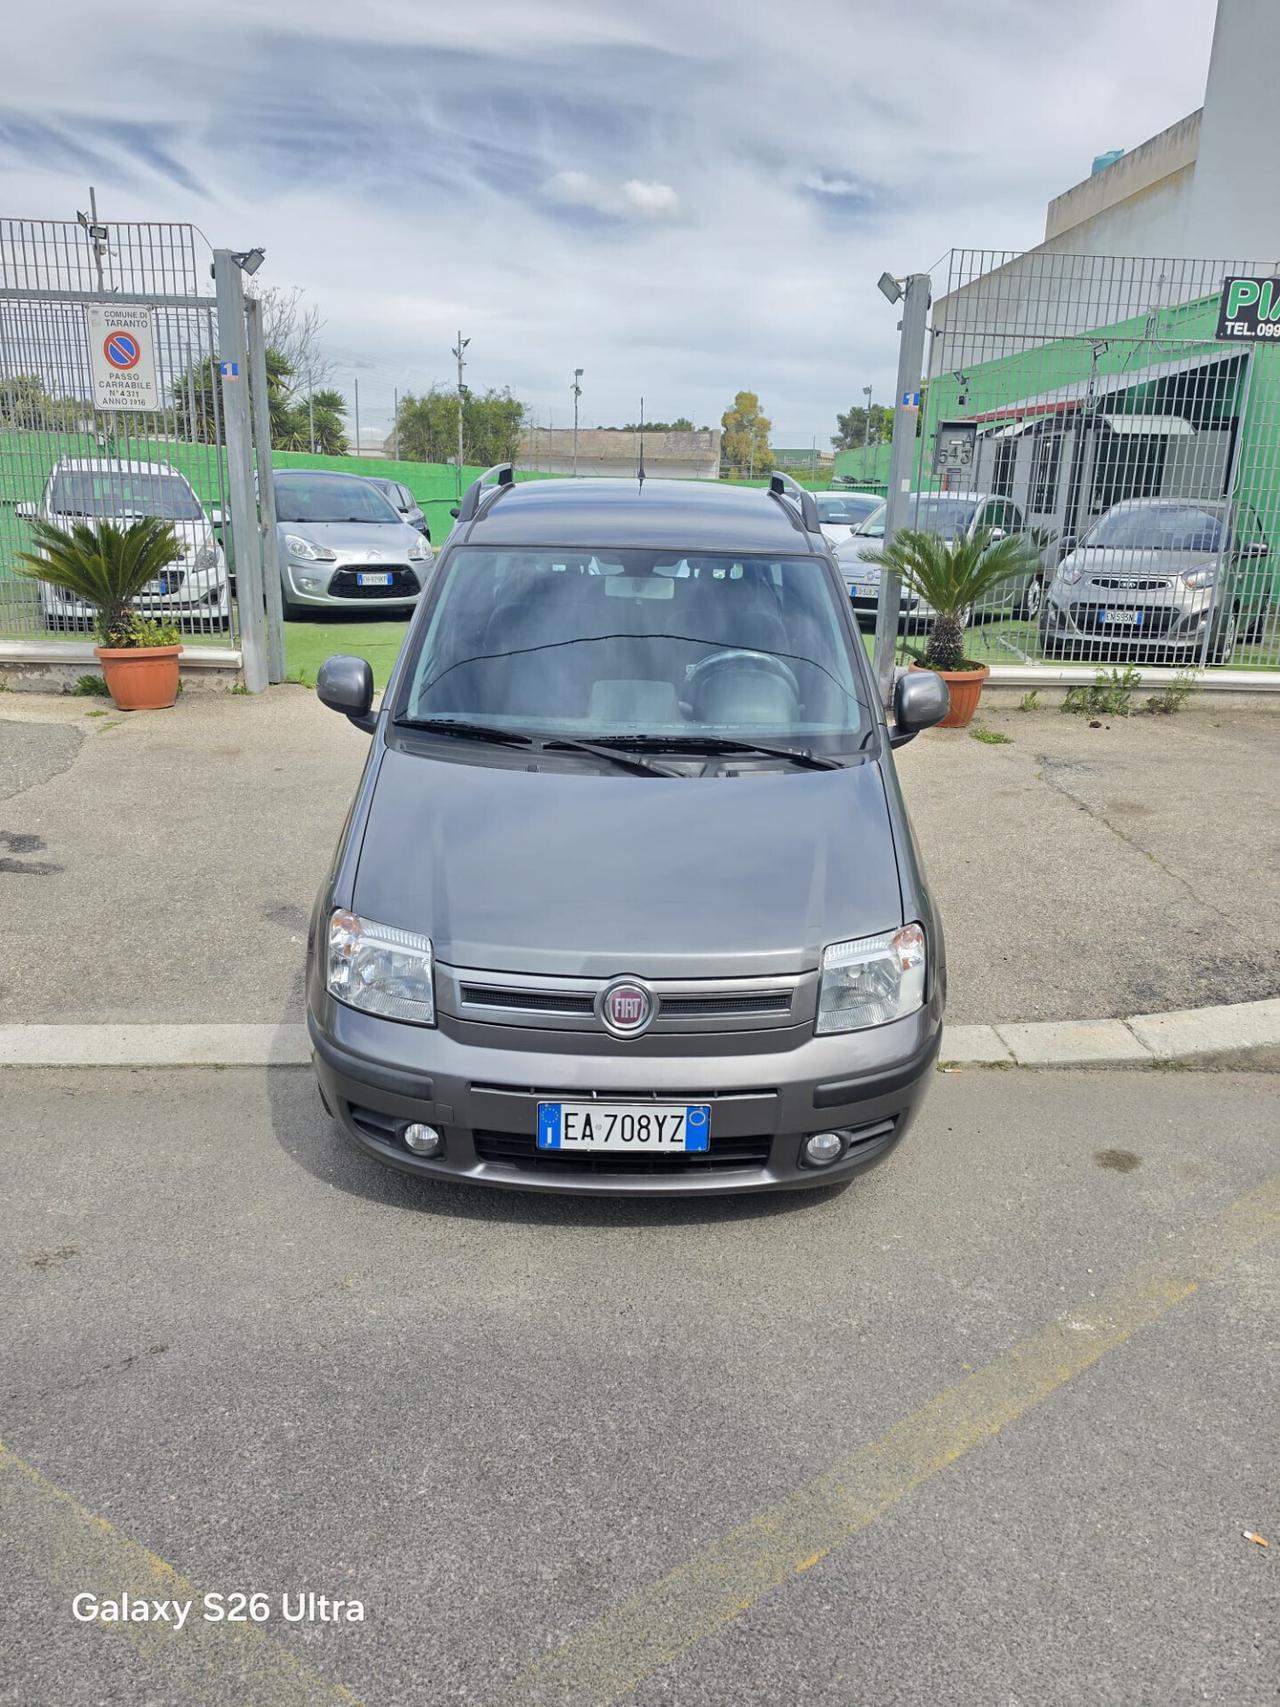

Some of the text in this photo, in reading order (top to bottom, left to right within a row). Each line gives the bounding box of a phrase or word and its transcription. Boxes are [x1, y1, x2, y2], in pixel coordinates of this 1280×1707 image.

[104, 311, 148, 319] COMUNE DI
[105, 319, 148, 328] TARANTO
[109, 372, 140, 381] PASSO
[98, 381, 151, 390] CARRABILE
[102, 398, 128, 406] ANNO
[939, 446, 971, 465] 543
[615, 998, 640, 1018] FIAT
